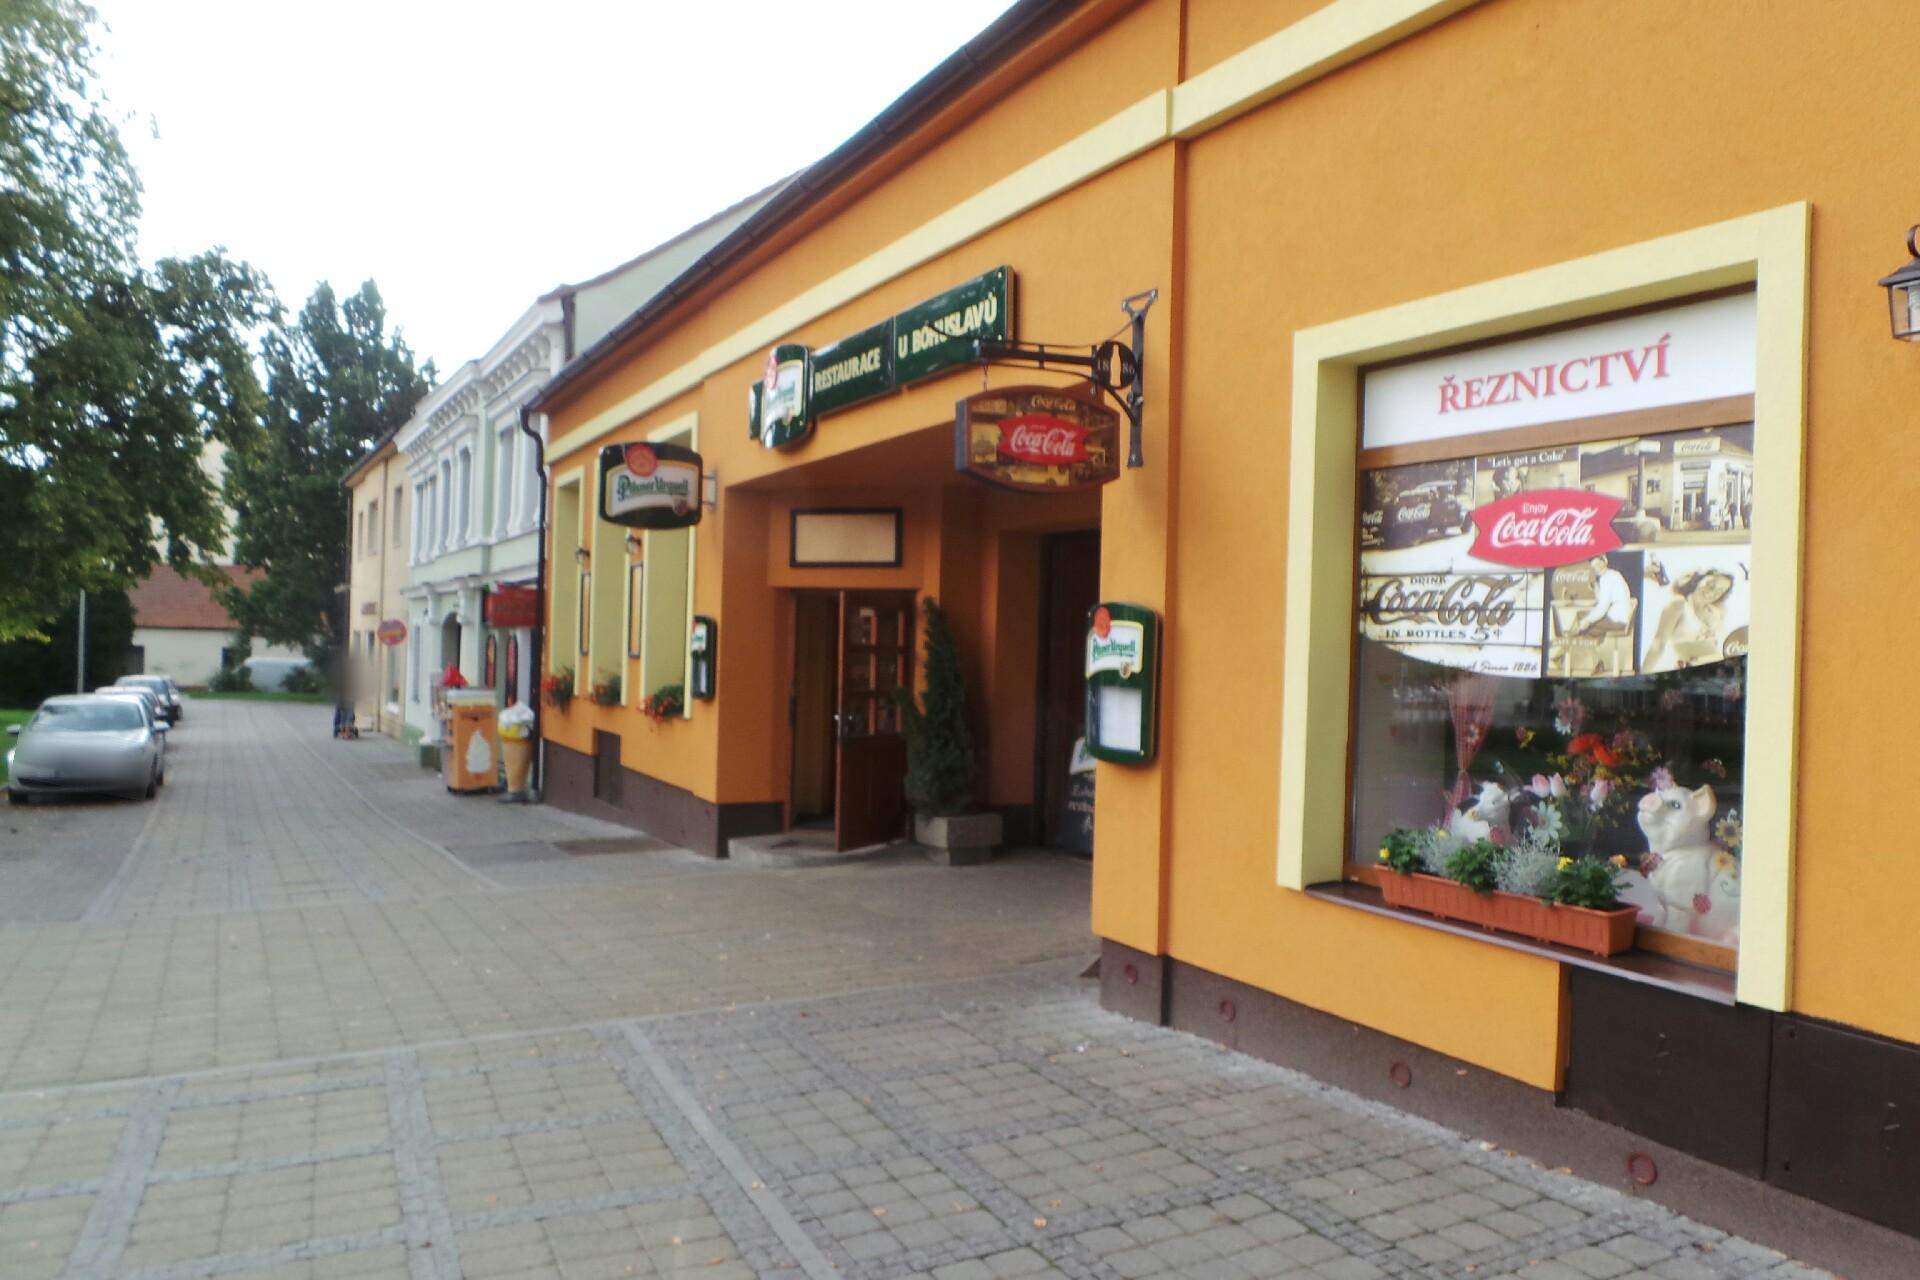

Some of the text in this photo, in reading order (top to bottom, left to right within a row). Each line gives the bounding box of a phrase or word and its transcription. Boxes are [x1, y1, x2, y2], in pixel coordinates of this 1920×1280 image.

[814, 347, 881, 392] RESTAURACE
[898, 335, 908, 358] U
[1438, 332, 1671, 414] ŘEZNICTVÍ
[1523, 502, 1548, 514] Enjoy
[1491, 507, 1599, 548] Coca-Cola
[1410, 575, 1446, 585] DRINK
[1367, 574, 1524, 626] Coca-Cola
[1385, 629, 1400, 639] IN
[1406, 629, 1466, 639] BOTTLES
[1512, 661, 1538, 673] 1886
